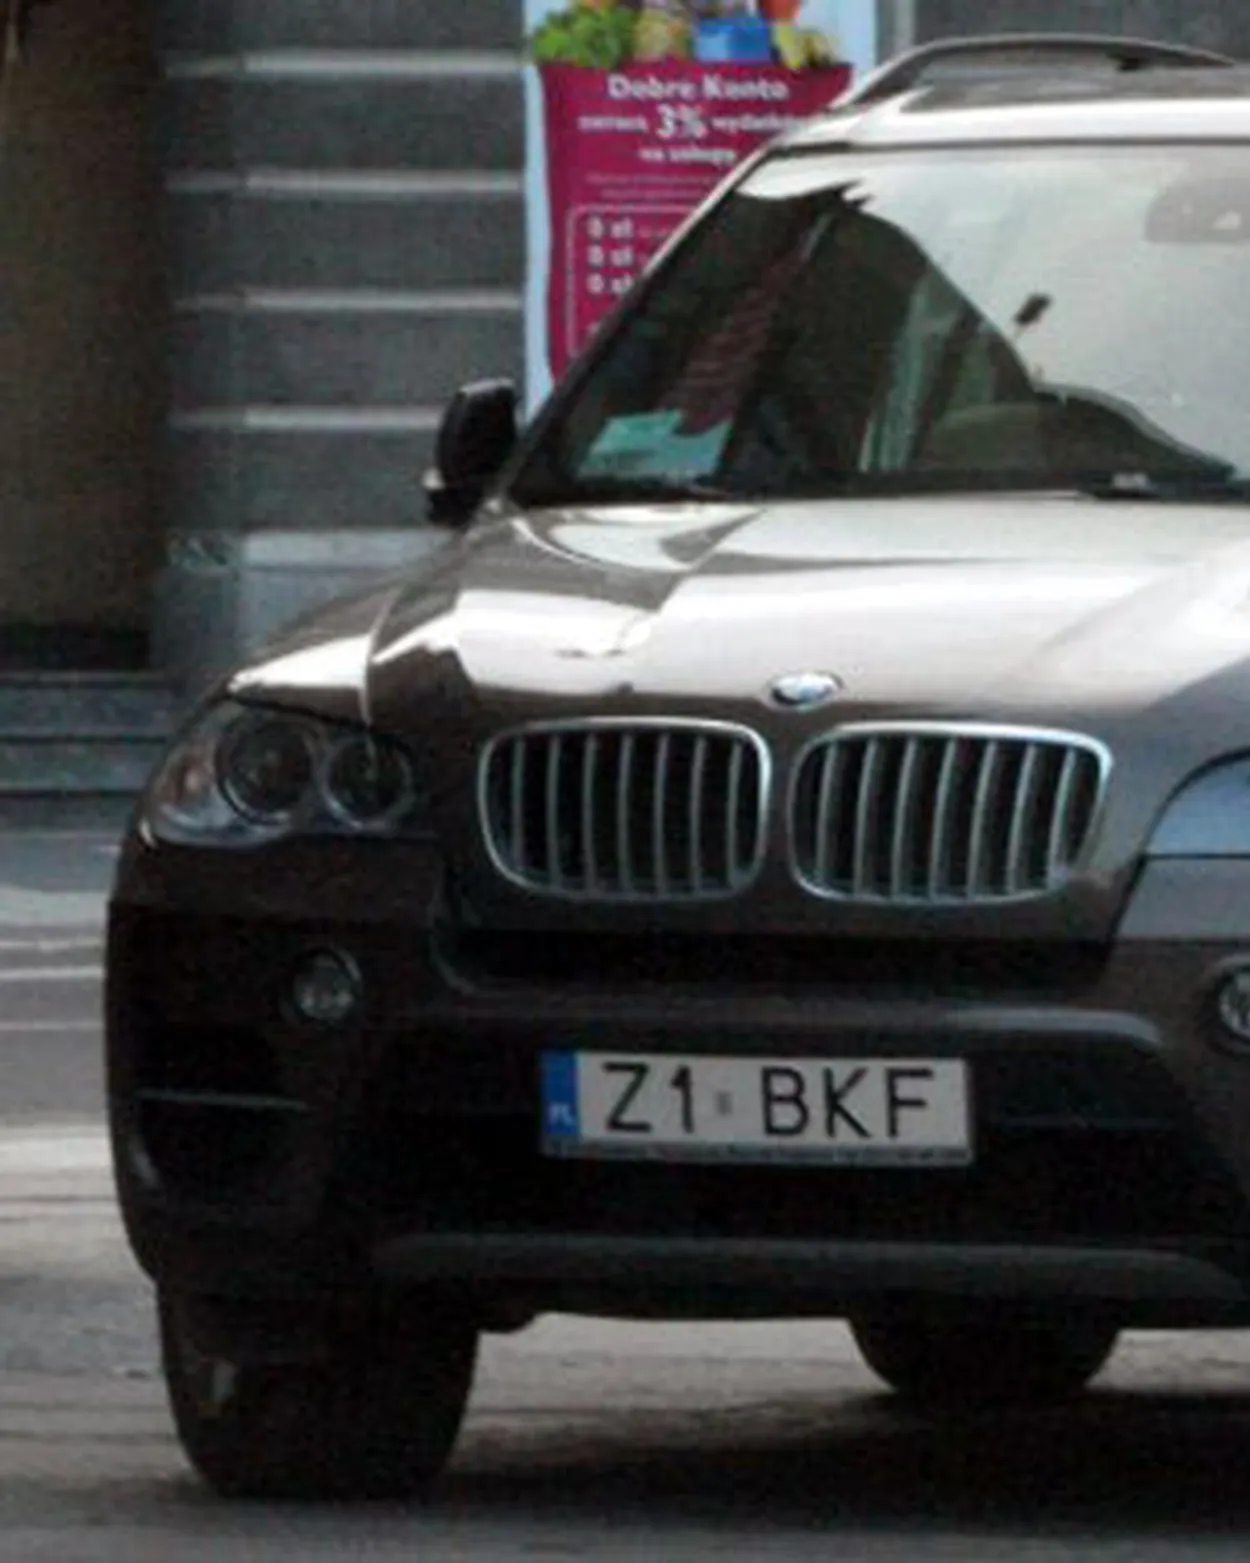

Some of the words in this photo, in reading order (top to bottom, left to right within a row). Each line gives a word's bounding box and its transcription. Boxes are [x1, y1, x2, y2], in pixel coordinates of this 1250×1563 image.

[608, 74, 694, 99] Dobre
[701, 74, 788, 99] Konto
[656, 104, 707, 138] 3%
[603, 1062, 695, 1134] Z1
[761, 1065, 935, 1138] BKF
